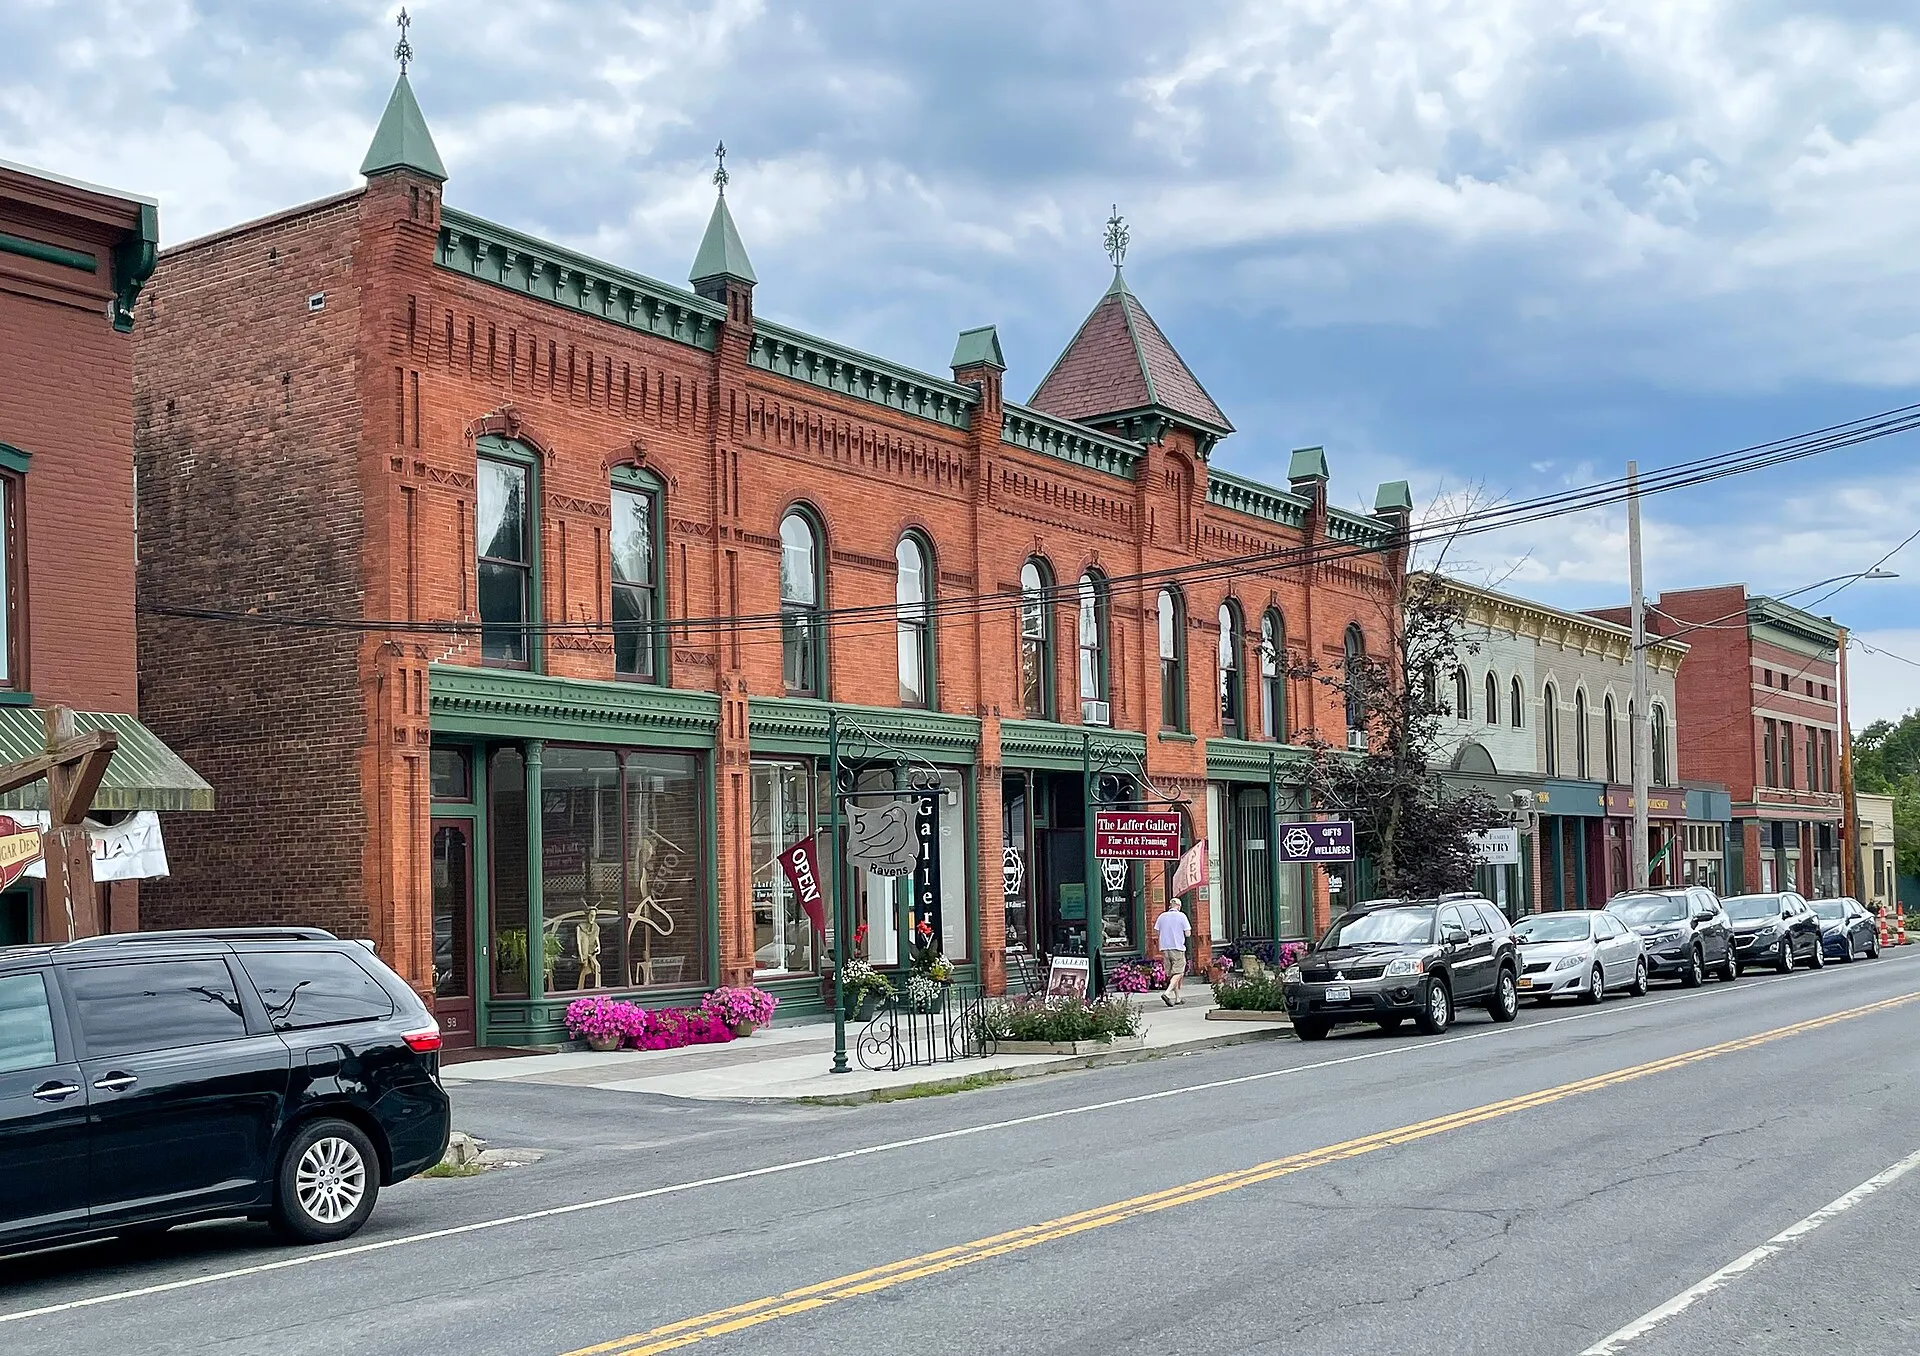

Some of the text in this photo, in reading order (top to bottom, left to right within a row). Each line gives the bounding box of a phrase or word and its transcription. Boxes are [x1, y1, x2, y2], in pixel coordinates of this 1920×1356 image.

[854, 812, 867, 834] 5
[1098, 819, 1178, 834] The Laffer Gallery
[1322, 828, 1342, 837] GIFTS
[1108, 836, 1168, 847] Fine Art & Framing
[1329, 837, 1335, 845] &
[0, 843, 18, 861] GAR
[1315, 846, 1350, 855] WELLNESS
[792, 848, 821, 903] OPEN
[869, 863, 908, 877] Ravens
[918, 797, 934, 949] Gallery
